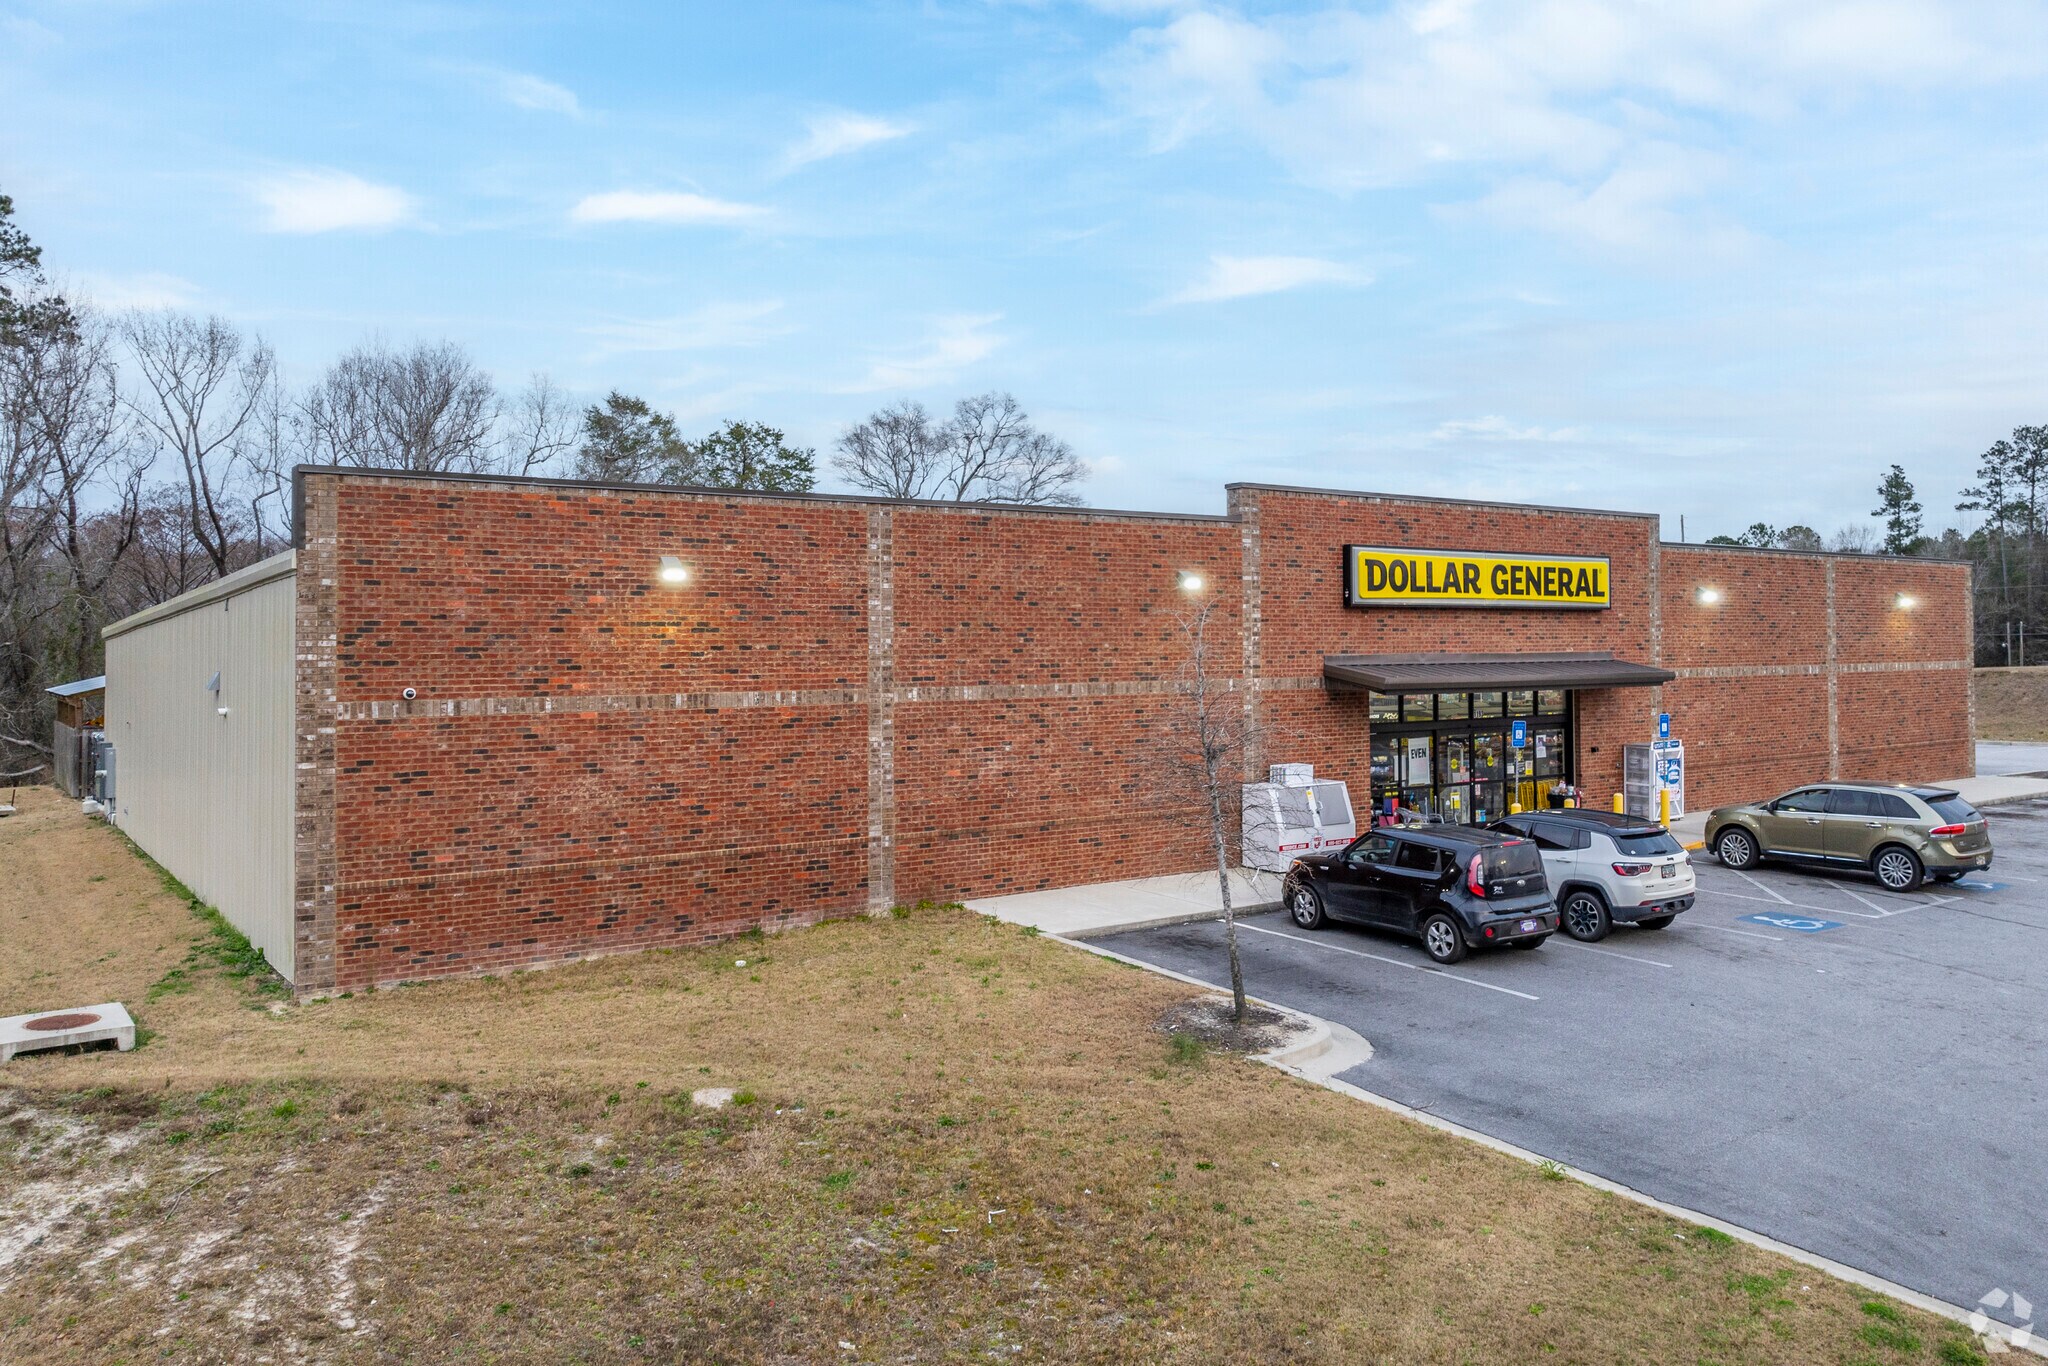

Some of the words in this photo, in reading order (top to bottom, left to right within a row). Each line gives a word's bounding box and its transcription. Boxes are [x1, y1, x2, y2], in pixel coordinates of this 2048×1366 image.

[1365, 558, 1481, 594] DOLLAR
[1491, 564, 1605, 598] GENERAL
[1411, 747, 1427, 760] EVEN
